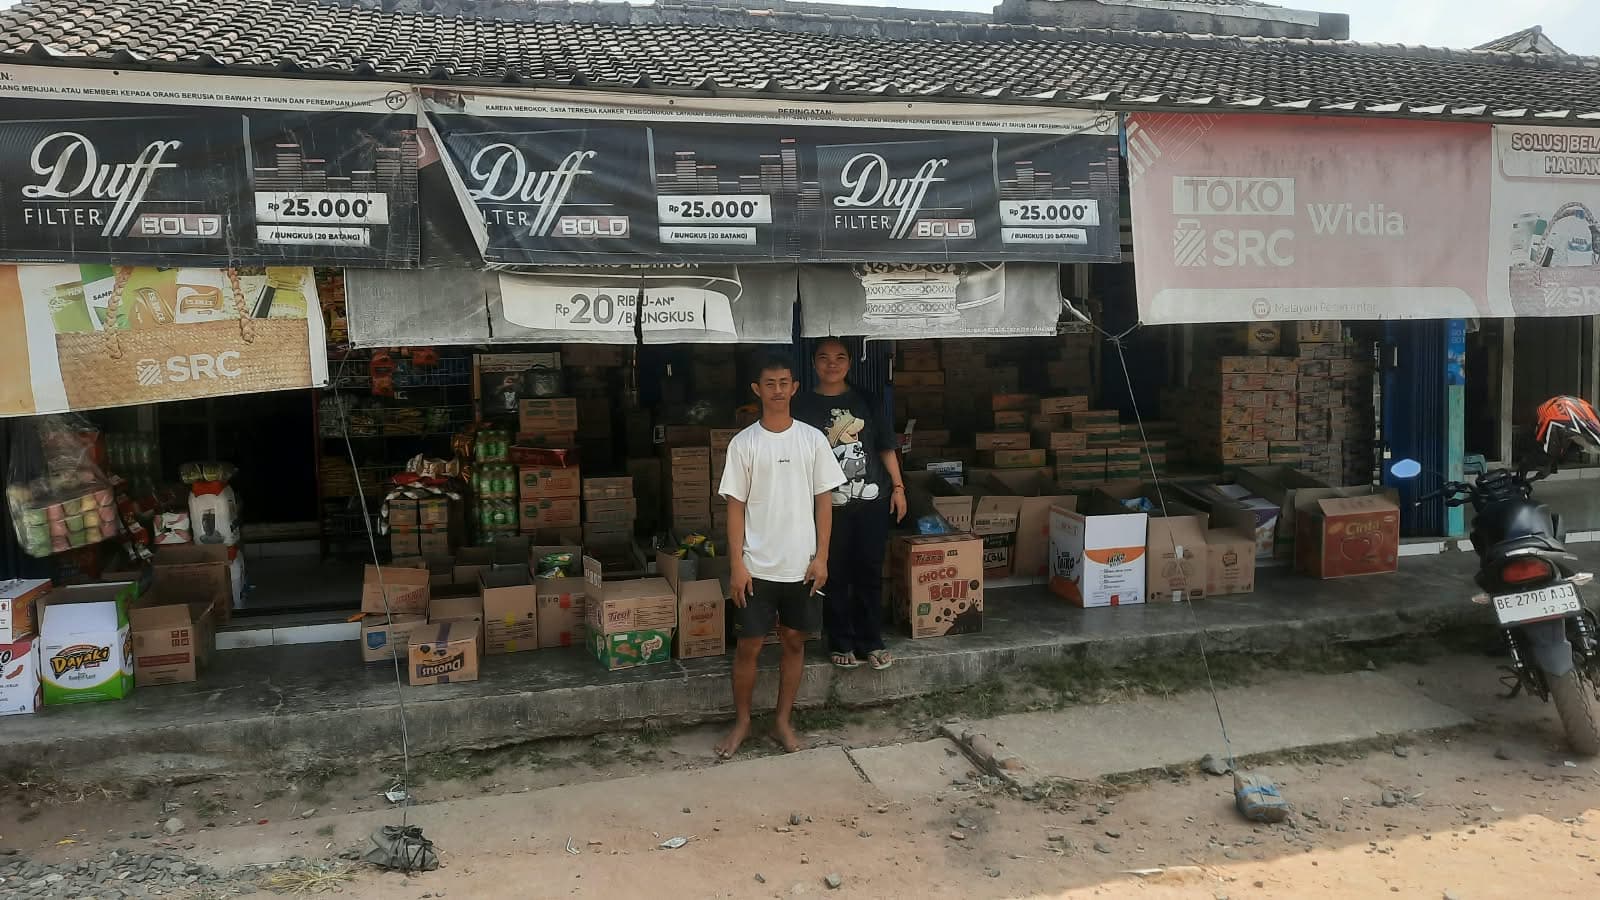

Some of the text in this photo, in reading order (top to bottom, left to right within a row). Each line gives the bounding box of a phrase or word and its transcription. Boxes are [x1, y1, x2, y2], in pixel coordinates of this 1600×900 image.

[21, 85, 60, 94] MENJUAL
[83, 88, 119, 96] MEMBERI
[120, 89, 151, 97] KEPADA
[153, 91, 180, 99] ORANG
[181, 92, 214, 100] BERUSIA
[225, 94, 252, 102] BAWAH
[306, 98, 350, 106] PEREMPUAN
[1512, 132, 1568, 153] SOLUSI
[22, 131, 184, 237] Duff
[470, 143, 597, 236] Duff
[834, 152, 949, 240] Duff
[1183, 179, 1284, 213] TOKO
[24, 208, 103, 226] FILTER
[267, 202, 280, 213] Rp
[483, 209, 532, 227] LTER
[668, 204, 680, 216] Rp
[1009, 208, 1019, 217] Rp
[140, 216, 220, 237] BOLD
[562, 217, 627, 236] BOLD
[834, 214, 891, 230] FILTER
[917, 221, 974, 238] BOLD
[1306, 202, 1406, 237] Widia
[1212, 228, 1295, 268] SRC
[555, 293, 614, 324] Rp 20
[165, 350, 242, 382] SRC
[918, 566, 958, 584] CHOCO
[1497, 598, 1513, 610] BE
[1550, 586, 1574, 600] AJJ
[50, 646, 110, 675] Dayaki
